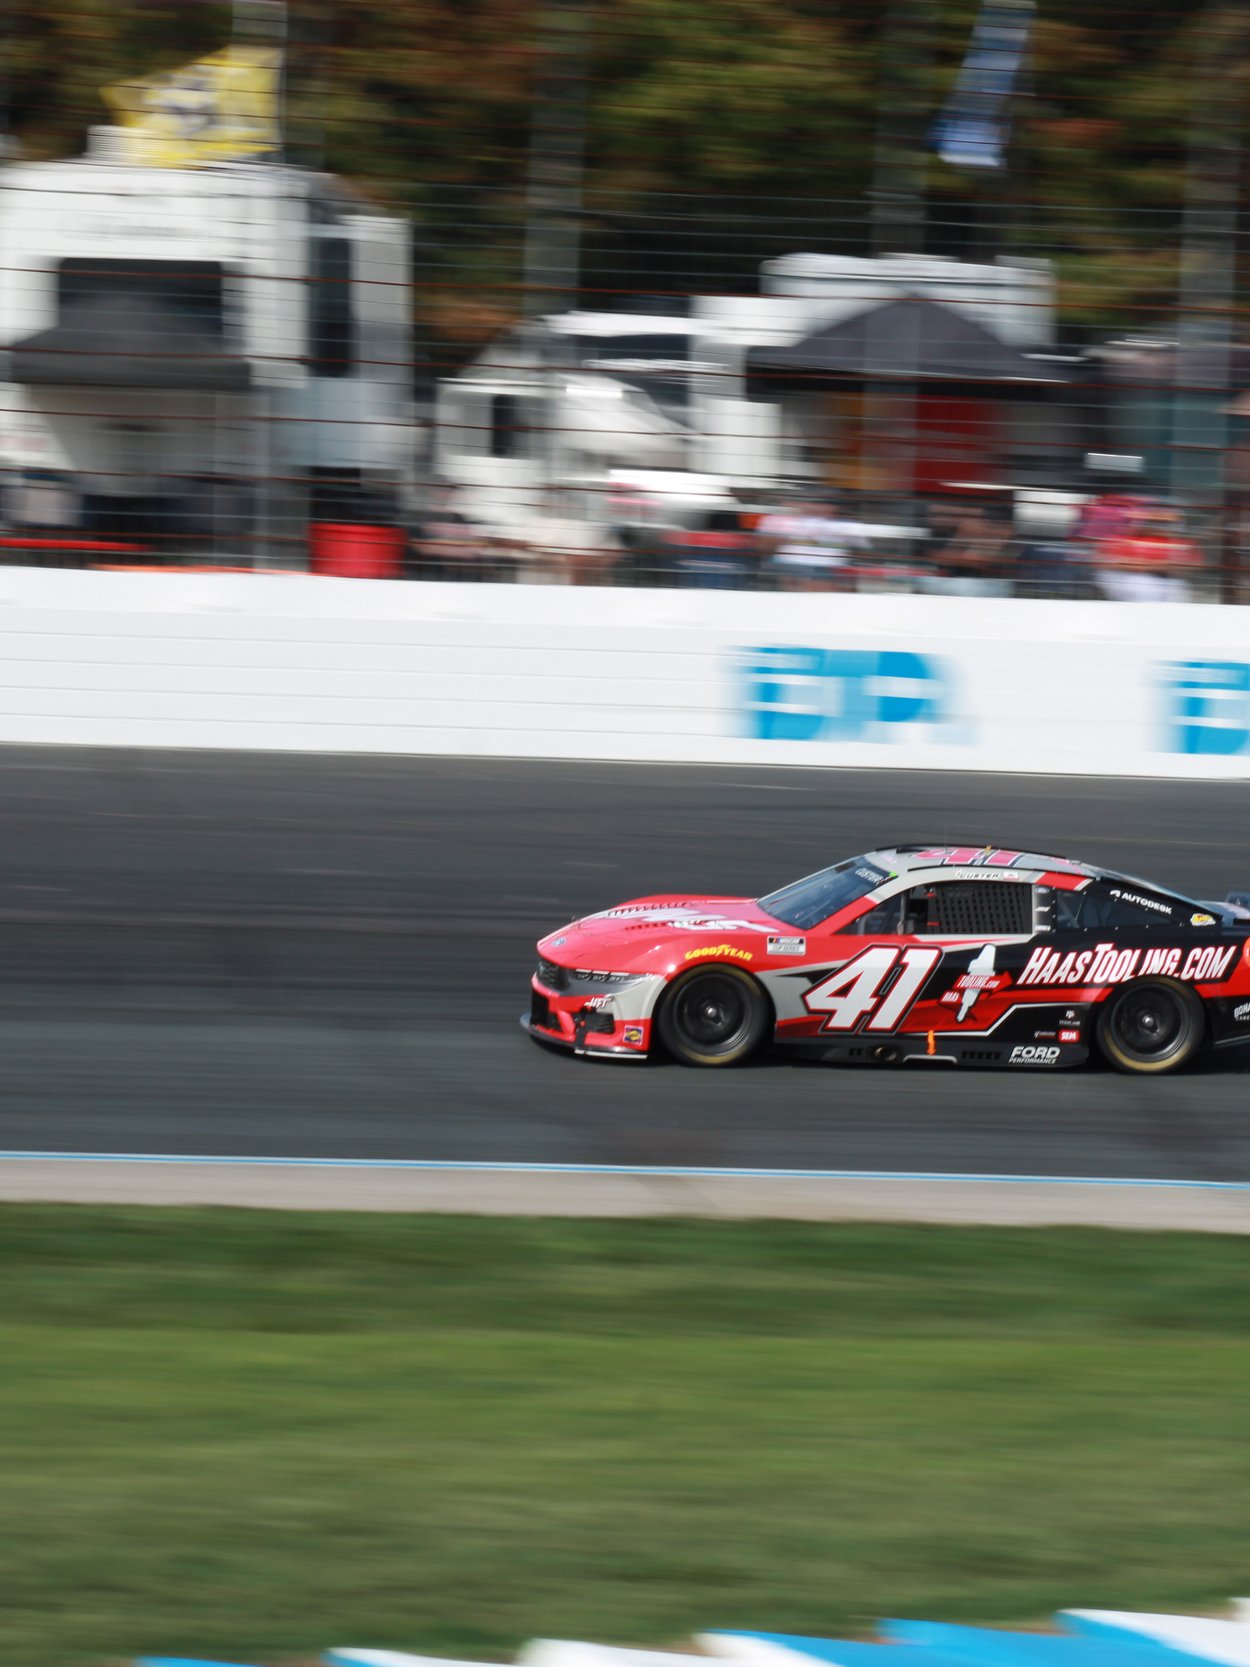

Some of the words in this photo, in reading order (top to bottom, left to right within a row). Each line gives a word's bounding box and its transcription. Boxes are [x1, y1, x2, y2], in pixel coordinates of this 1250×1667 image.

[1121, 892, 1173, 914] AUTODESK
[684, 943, 754, 961] GOODYEAR
[804, 946, 941, 1030] 41
[1010, 1045, 1061, 1059] FORD
